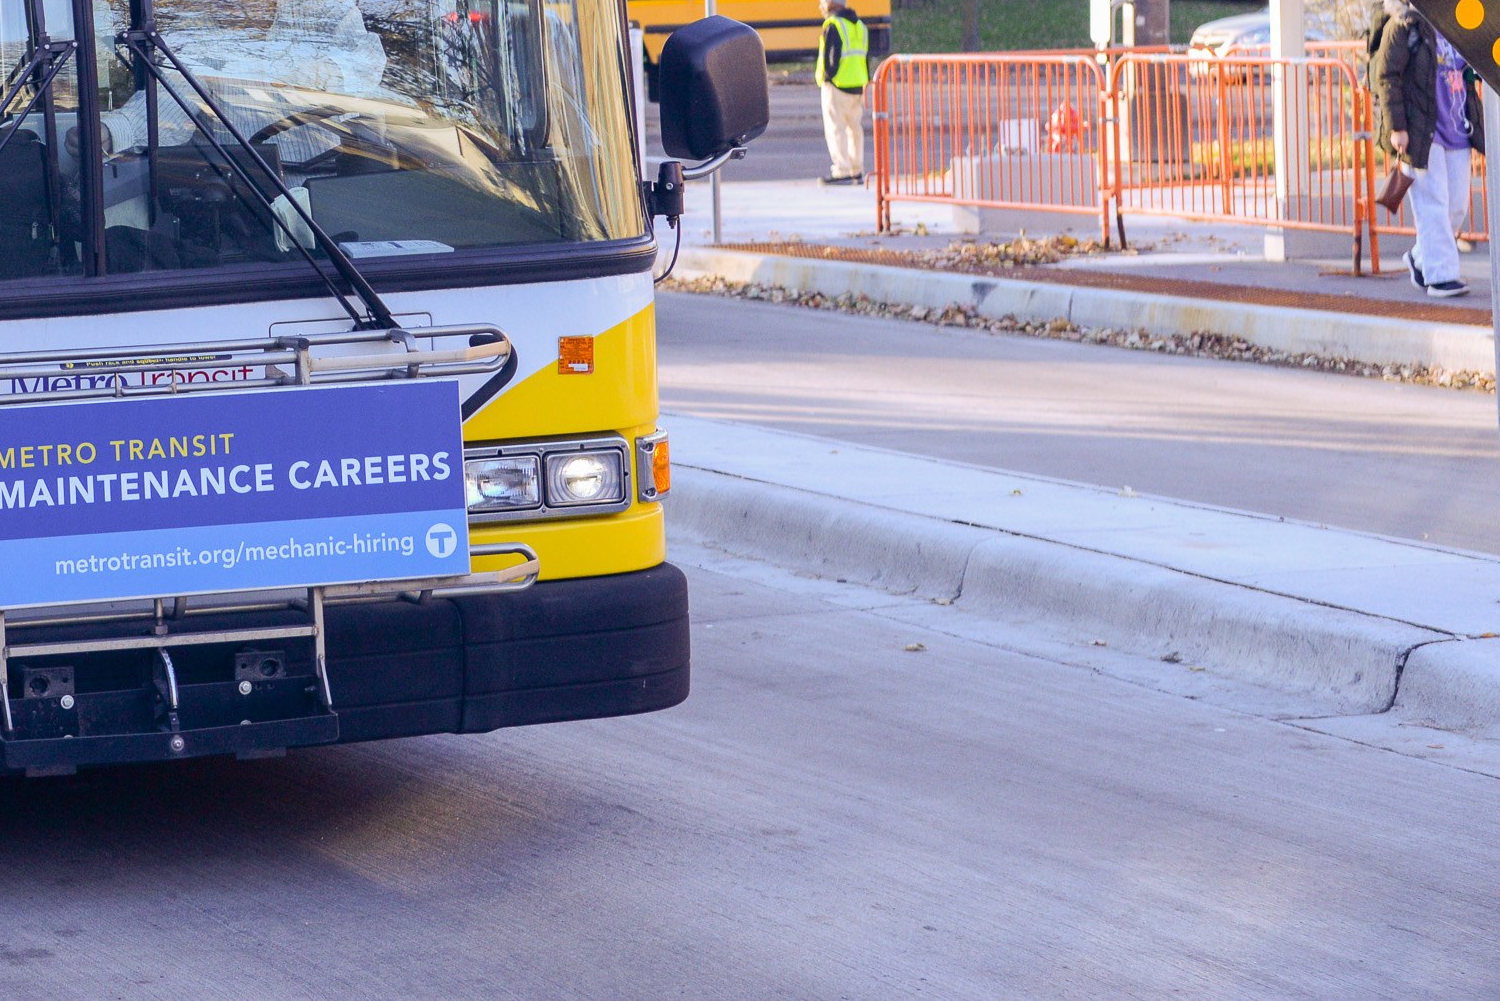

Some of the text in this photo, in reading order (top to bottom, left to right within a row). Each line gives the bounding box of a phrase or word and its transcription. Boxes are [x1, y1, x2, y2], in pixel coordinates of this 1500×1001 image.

[110, 433, 235, 462] TRANSIT
[288, 451, 451, 490] CAREERS
[55, 532, 415, 575] metrotransit.org/mechanic-hiring
